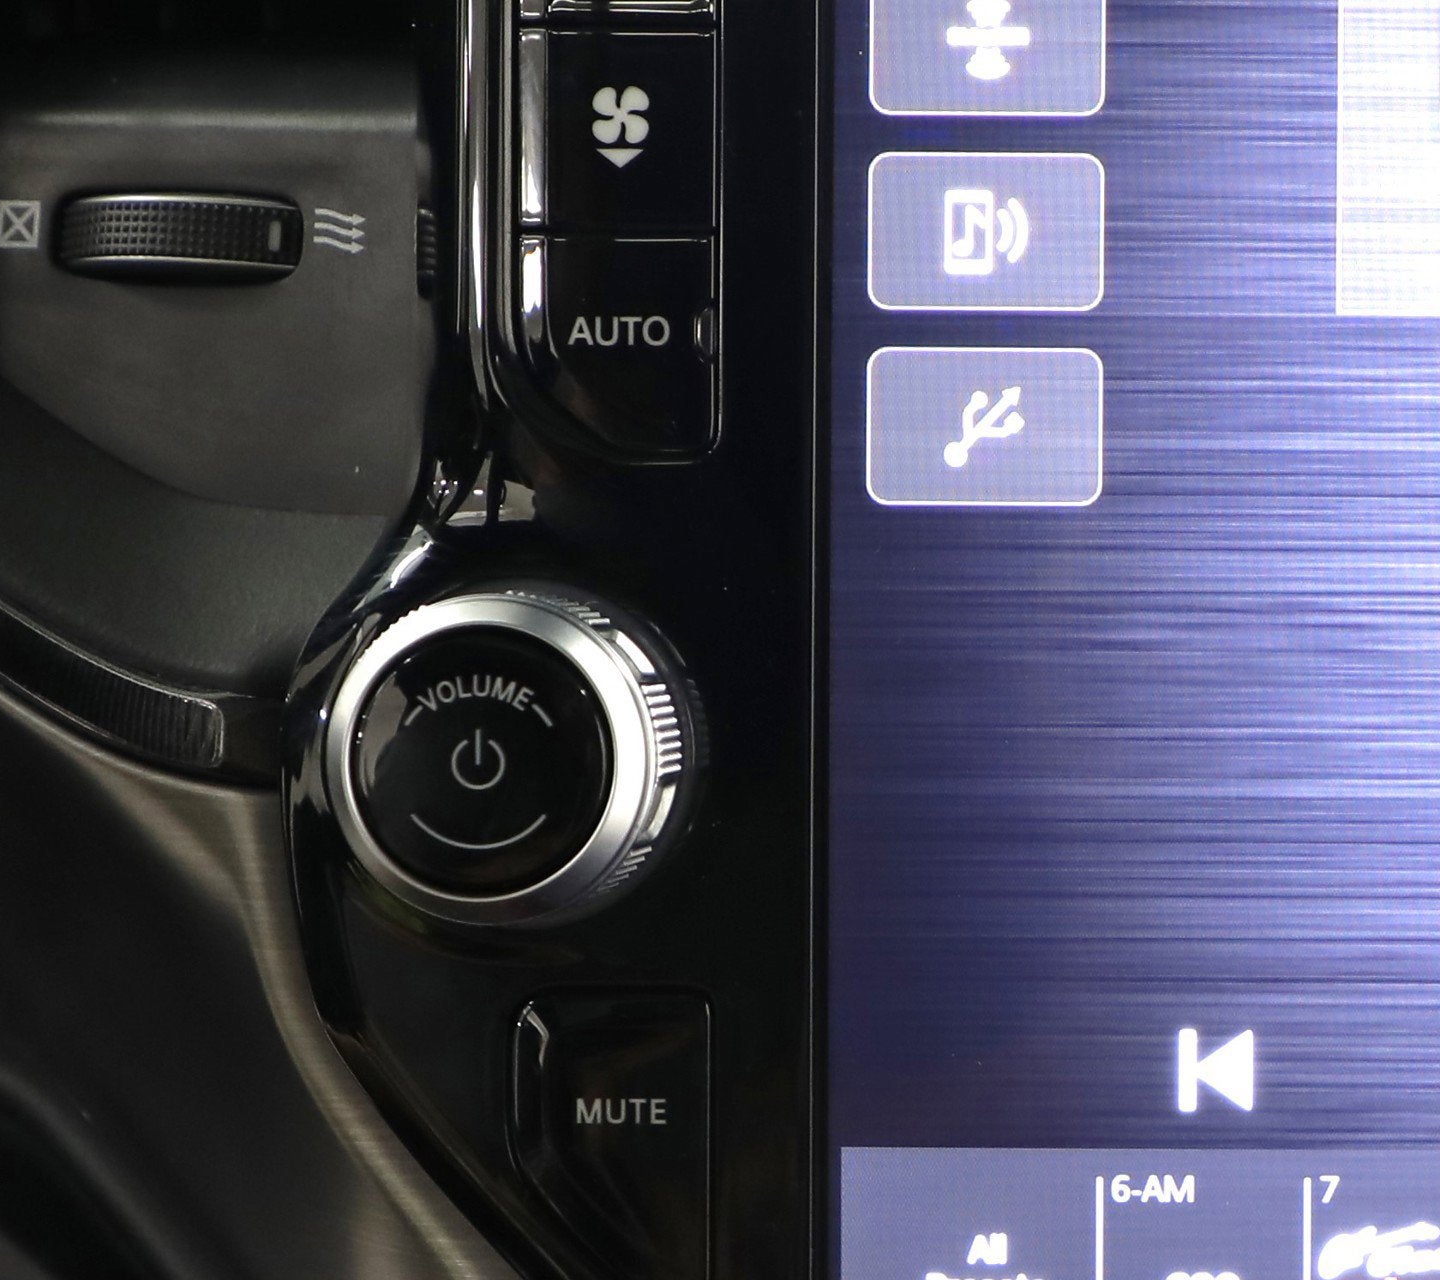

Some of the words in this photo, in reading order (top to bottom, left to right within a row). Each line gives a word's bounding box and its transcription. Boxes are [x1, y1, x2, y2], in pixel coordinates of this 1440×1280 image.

[568, 317, 670, 347] AUTO
[419, 675, 534, 711] VOLUME
[576, 1098, 667, 1125] MUTE
[1111, 1175, 1195, 1204] 6-AM
[1319, 1175, 1340, 1204] 7
[967, 1234, 1008, 1266] All
